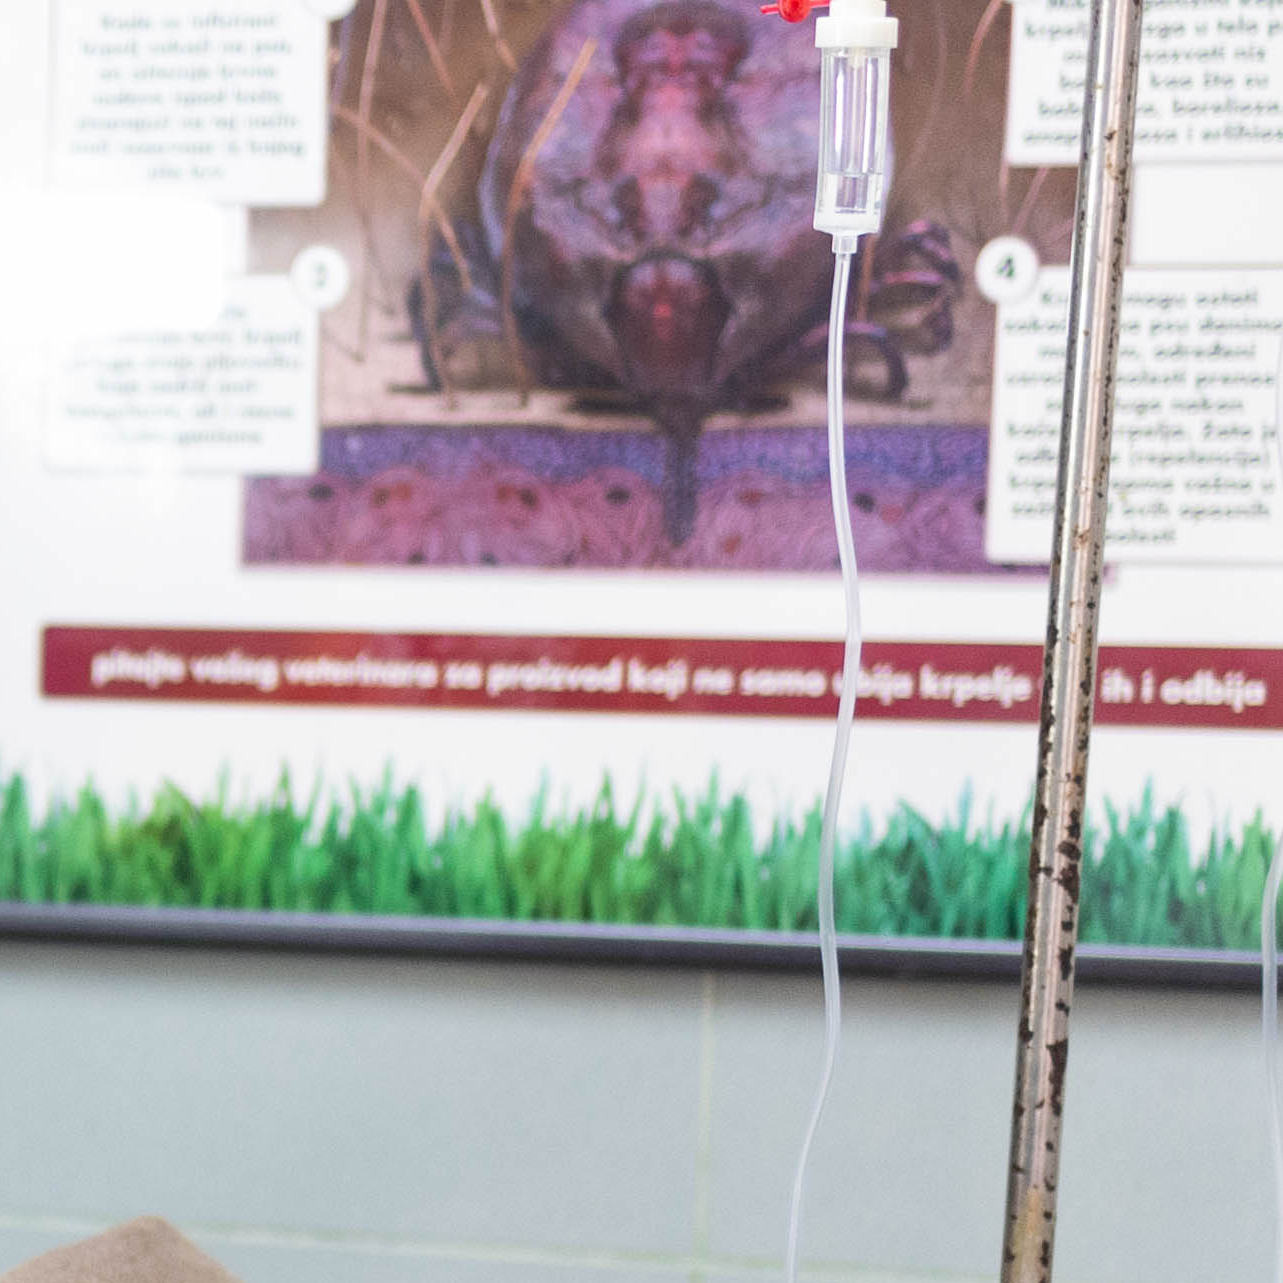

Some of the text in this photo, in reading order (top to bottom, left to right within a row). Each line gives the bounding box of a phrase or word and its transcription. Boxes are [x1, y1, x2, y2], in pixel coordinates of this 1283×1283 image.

[995, 257, 1015, 279] 4
[284, 652, 437, 688] veterinara
[444, 663, 482, 690] za
[487, 657, 622, 697] proizvod
[628, 658, 687, 701] koji
[692, 667, 733, 695] ne
[739, 669, 826, 698] samo
[920, 664, 1034, 708] krpelje
[1101, 667, 1134, 704] ih
[1160, 669, 1267, 713] odbija
